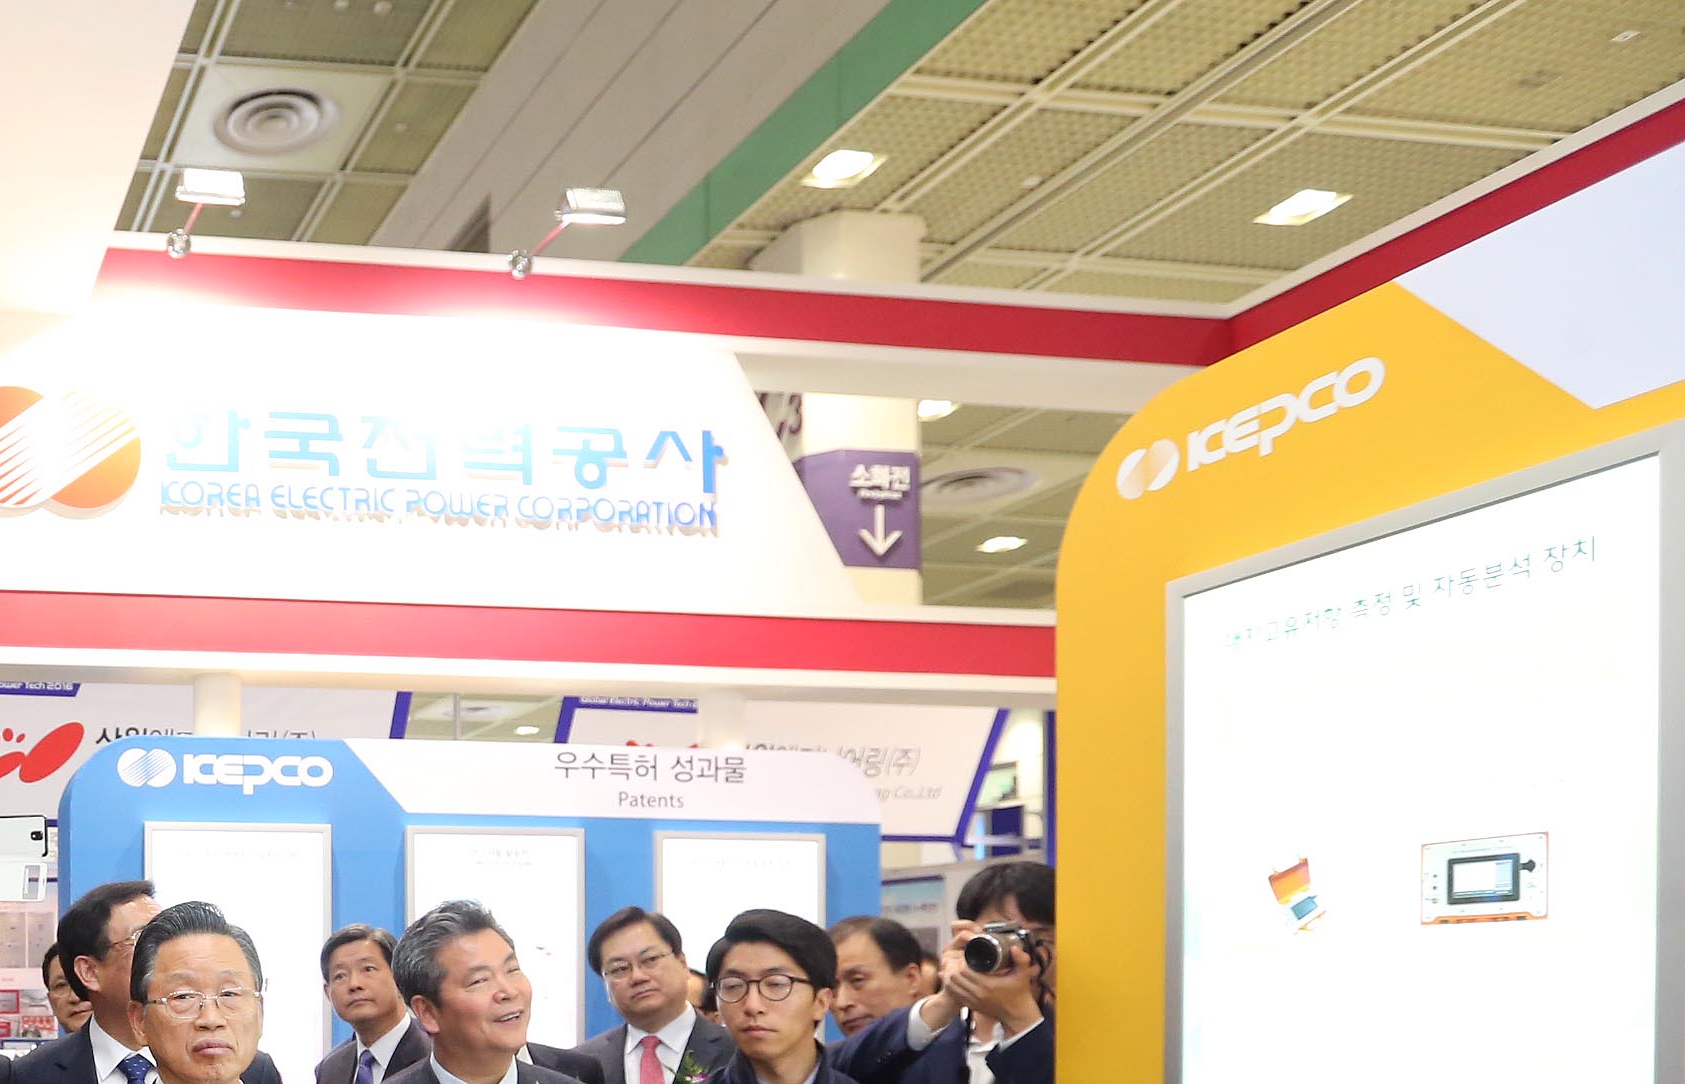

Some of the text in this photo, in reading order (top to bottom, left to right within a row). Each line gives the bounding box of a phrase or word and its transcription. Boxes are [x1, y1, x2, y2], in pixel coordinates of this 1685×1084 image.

[1186, 356, 1385, 472] KEPCO
[161, 481, 716, 527] KOREA ELECTRIC POWER CORPORATION
[1544, 535, 1596, 573] 장치
[183, 753, 334, 795] KEPCO
[554, 752, 747, 784] 우수특허 성과물
[619, 791, 684, 808] Patents
